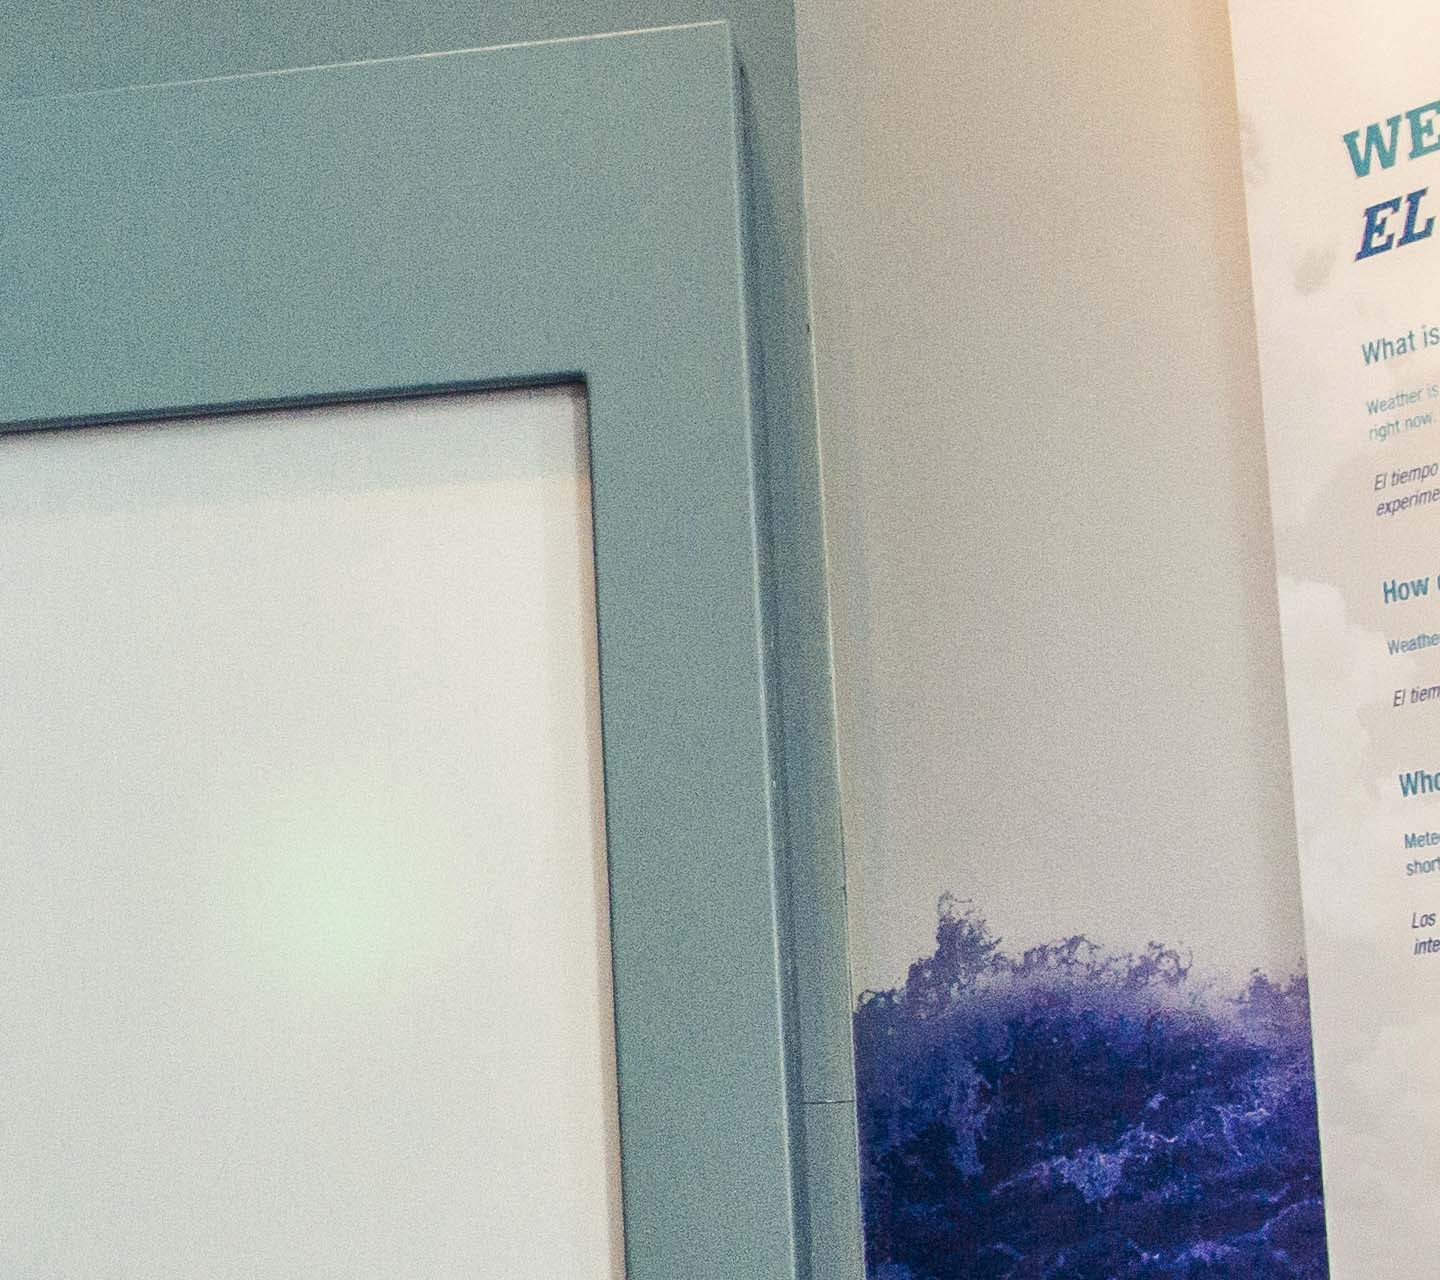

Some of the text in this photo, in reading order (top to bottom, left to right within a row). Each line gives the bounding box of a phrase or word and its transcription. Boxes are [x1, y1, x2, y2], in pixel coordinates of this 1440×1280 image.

[1354, 187, 1435, 262] EL
[1361, 330, 1416, 365] What
[1422, 325, 1440, 348] is
[1374, 473, 1387, 492] El
[1391, 462, 1439, 487] tiempo
[1383, 577, 1430, 604] How
[1393, 689, 1407, 708] El
[1411, 912, 1436, 929] Los
